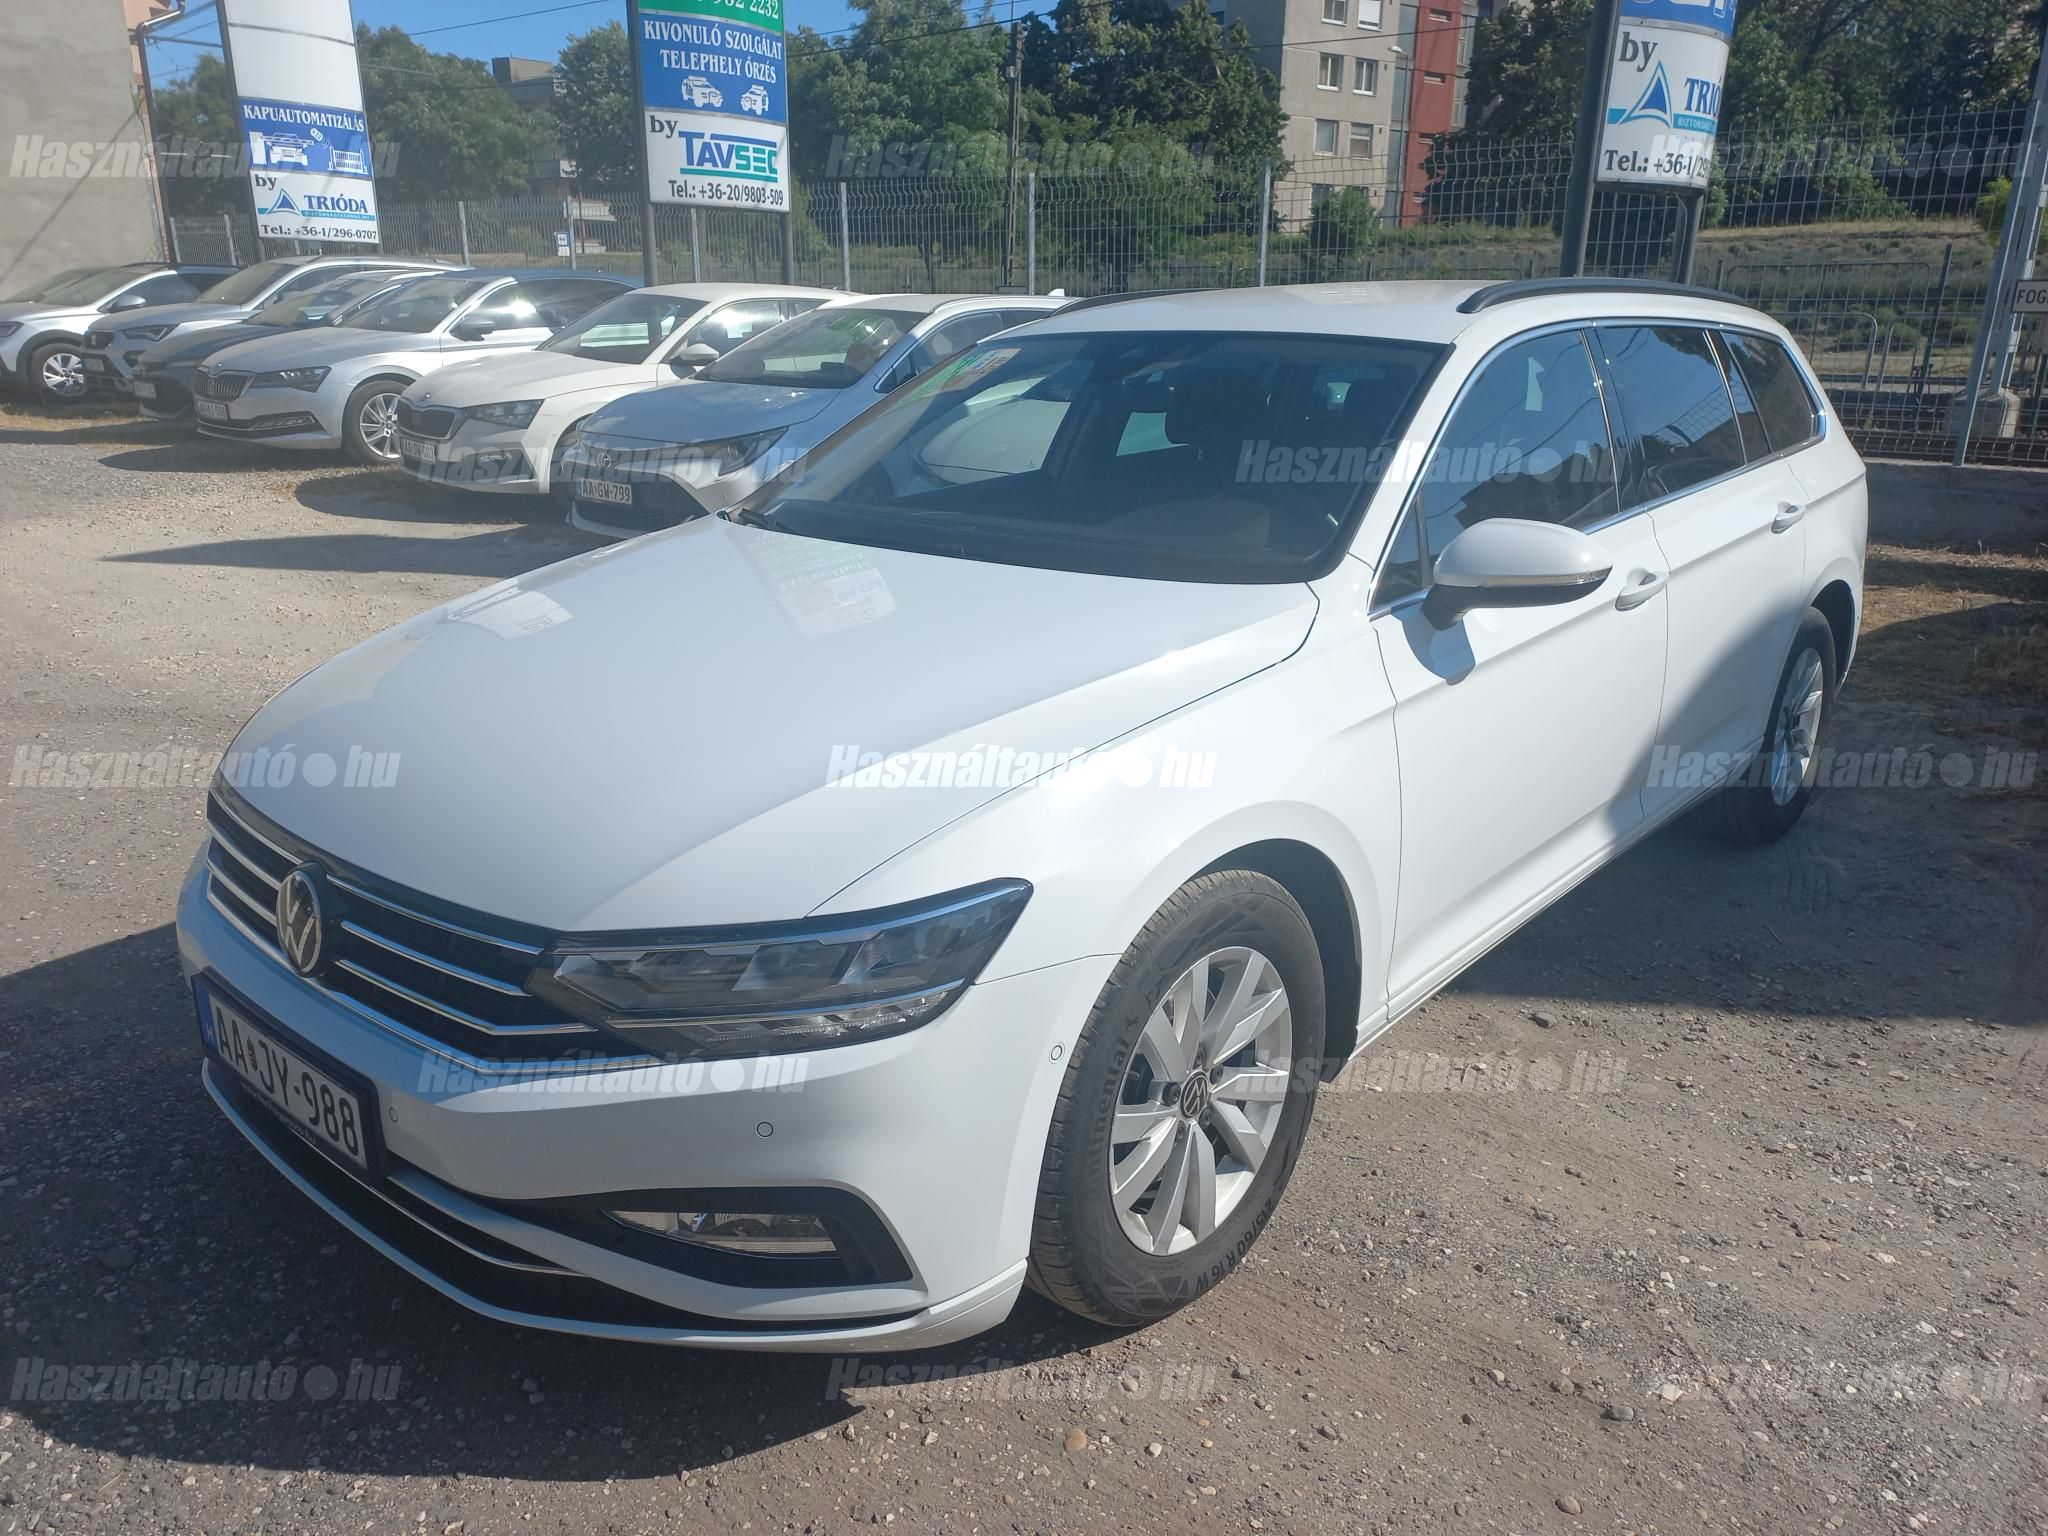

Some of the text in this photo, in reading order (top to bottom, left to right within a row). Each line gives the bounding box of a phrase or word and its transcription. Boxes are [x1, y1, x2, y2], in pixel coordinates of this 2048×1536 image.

[643, 20, 782, 60] KIVONULÓ SZOLGÁLAT
[660, 49, 742, 76] TELEPHELY
[1618, 32, 1658, 72] by
[243, 104, 365, 132] KAPUAUTOMATIZÁLÁS
[650, 116, 678, 138] by
[1604, 150, 1649, 172] Tel.:
[254, 174, 278, 191] by
[669, 179, 783, 205] Tel.: +36-20/9803-509
[304, 193, 369, 213] TRIÓDA
[262, 224, 377, 239] Tel.: +36-1/296-0707
[2016, 289, 2048, 304] FOG
[216, 1006, 249, 1074] AA
[258, 1039, 359, 1157] JY-988
[1227, 1256, 1237, 1269] R
